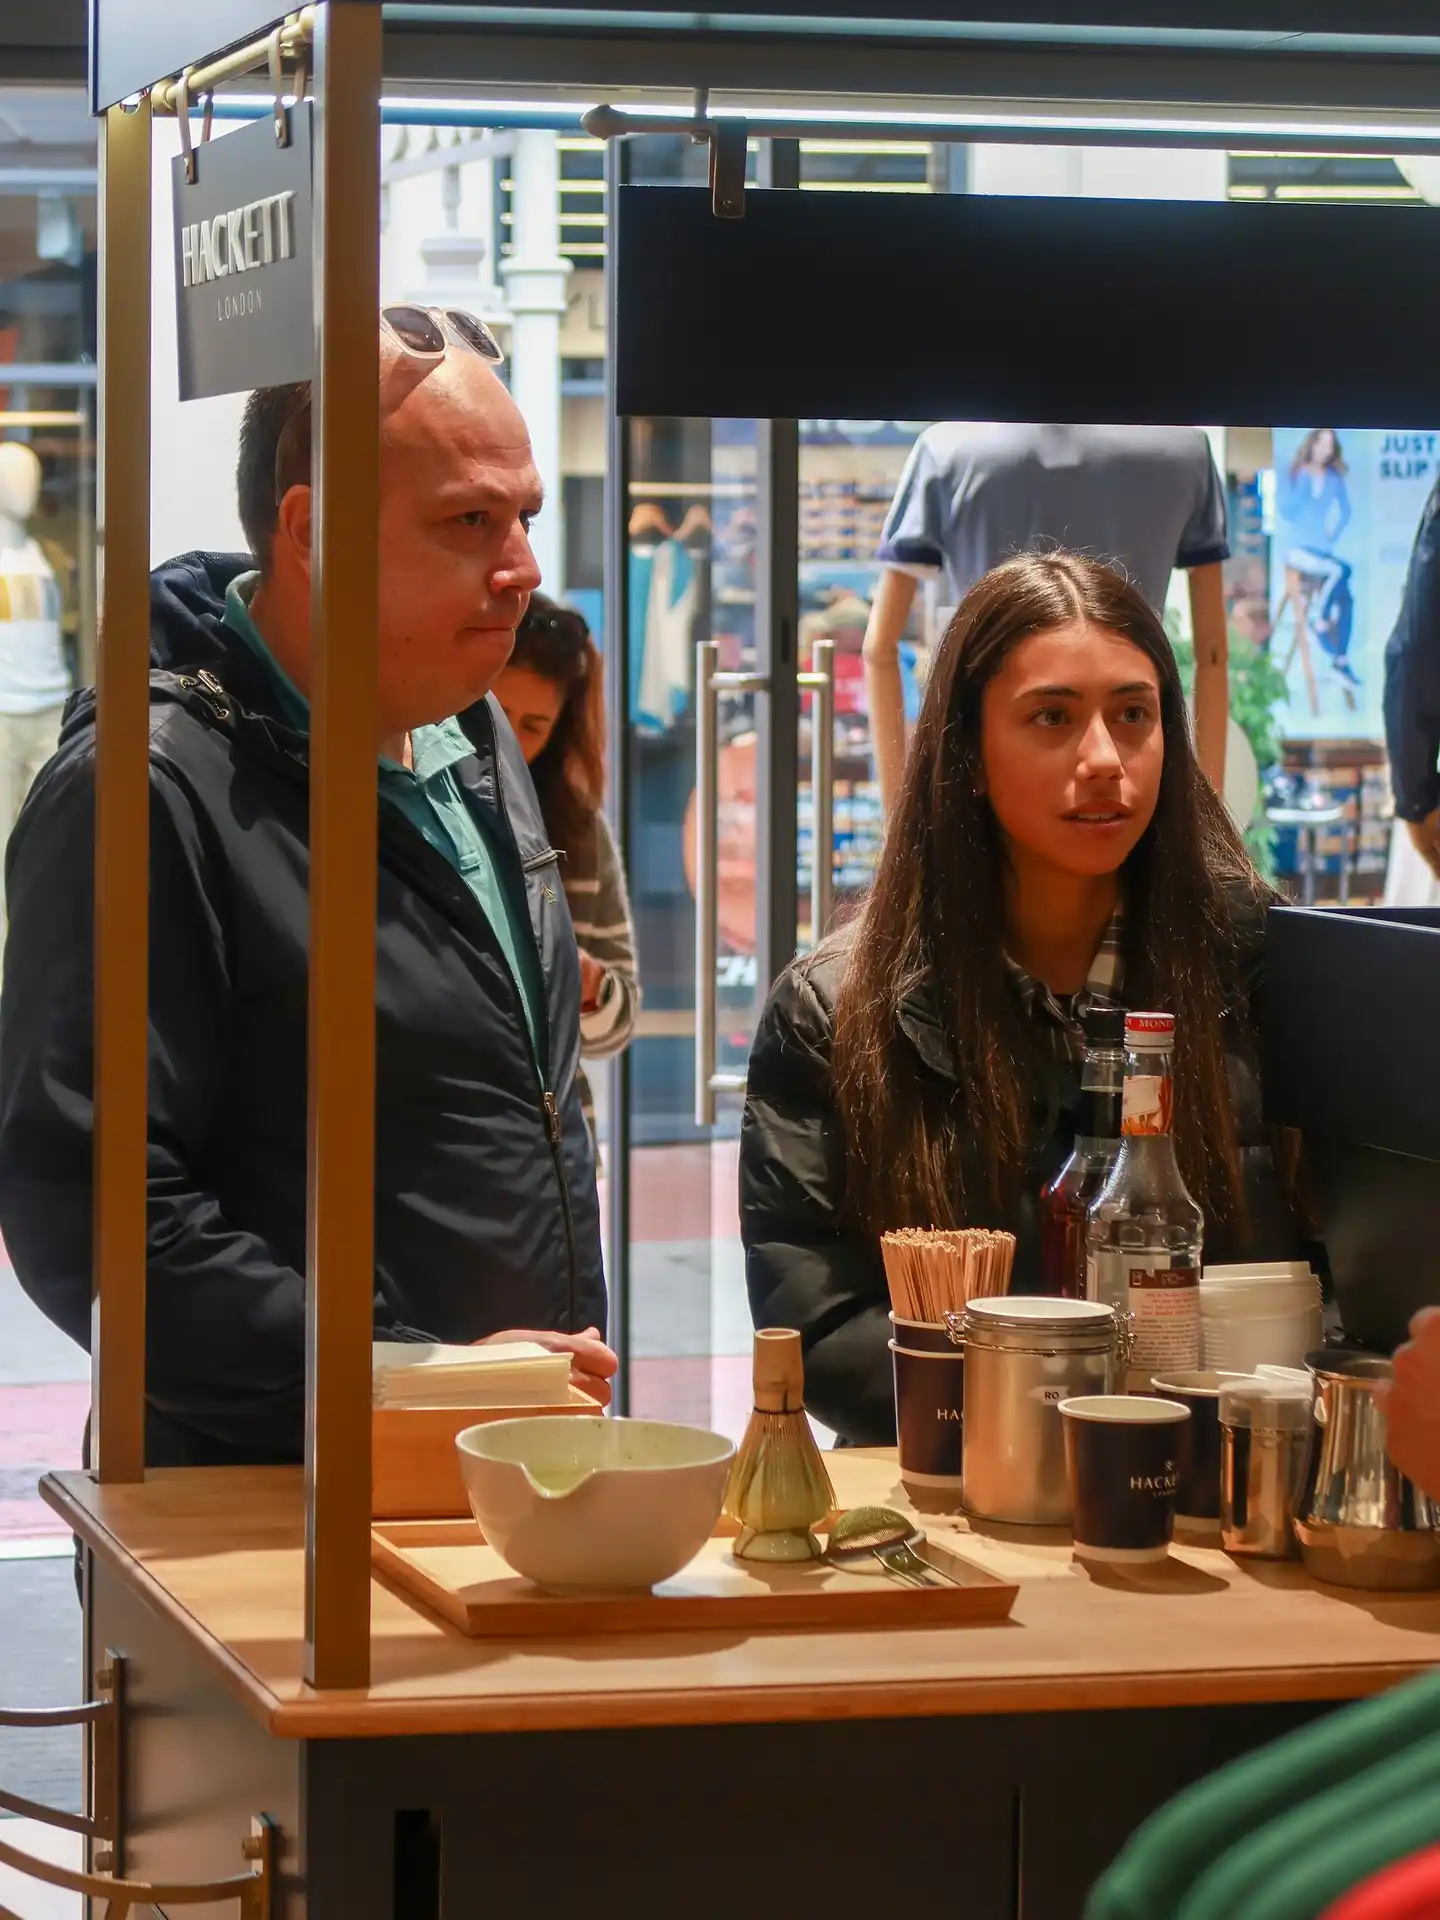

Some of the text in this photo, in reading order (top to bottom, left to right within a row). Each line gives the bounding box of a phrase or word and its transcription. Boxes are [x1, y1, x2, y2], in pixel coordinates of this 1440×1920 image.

[181, 190, 294, 287] HACKETT
[217, 289, 262, 321] LONDON
[1381, 434, 1435, 454] JUST
[1381, 460, 1428, 480] SLIP
